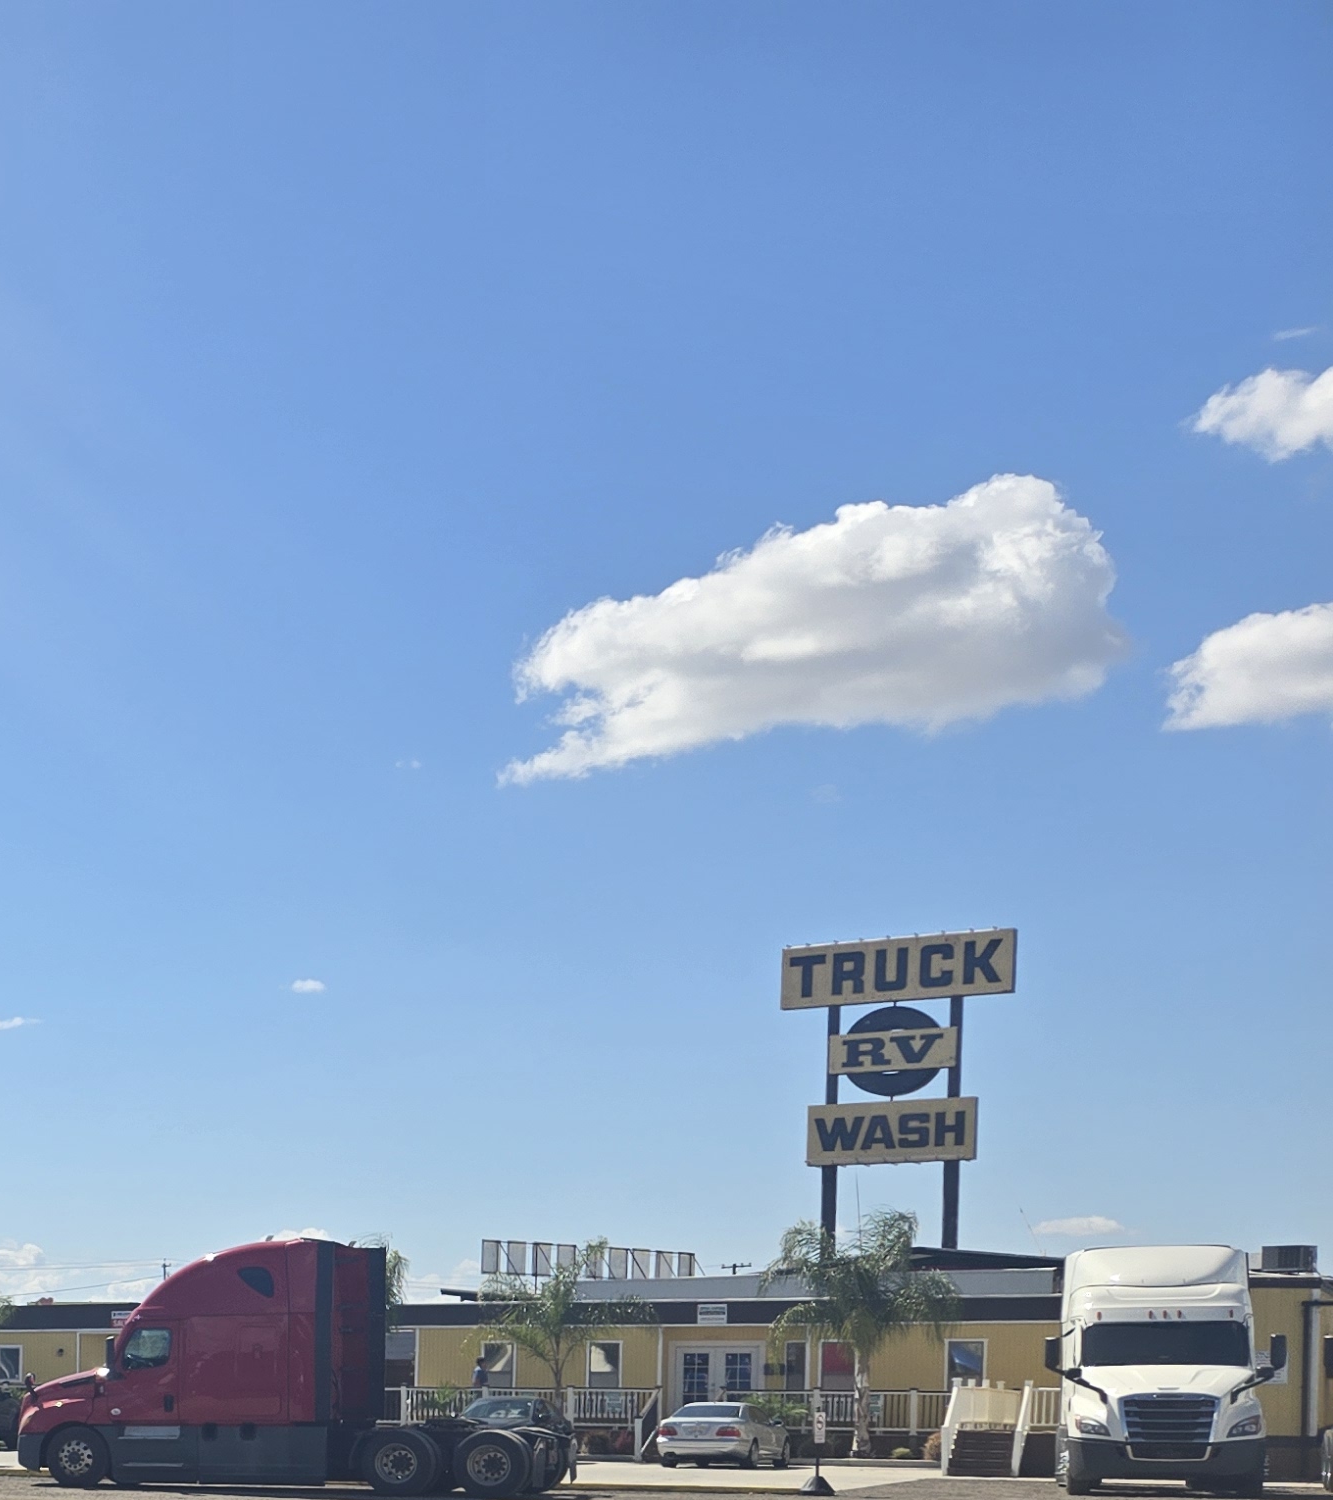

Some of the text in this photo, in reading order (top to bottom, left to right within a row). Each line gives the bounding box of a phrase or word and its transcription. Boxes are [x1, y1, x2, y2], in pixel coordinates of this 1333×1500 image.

[790, 938, 1003, 998] TRUCK
[841, 1033, 943, 1068] RV
[815, 1111, 966, 1152] WASH
